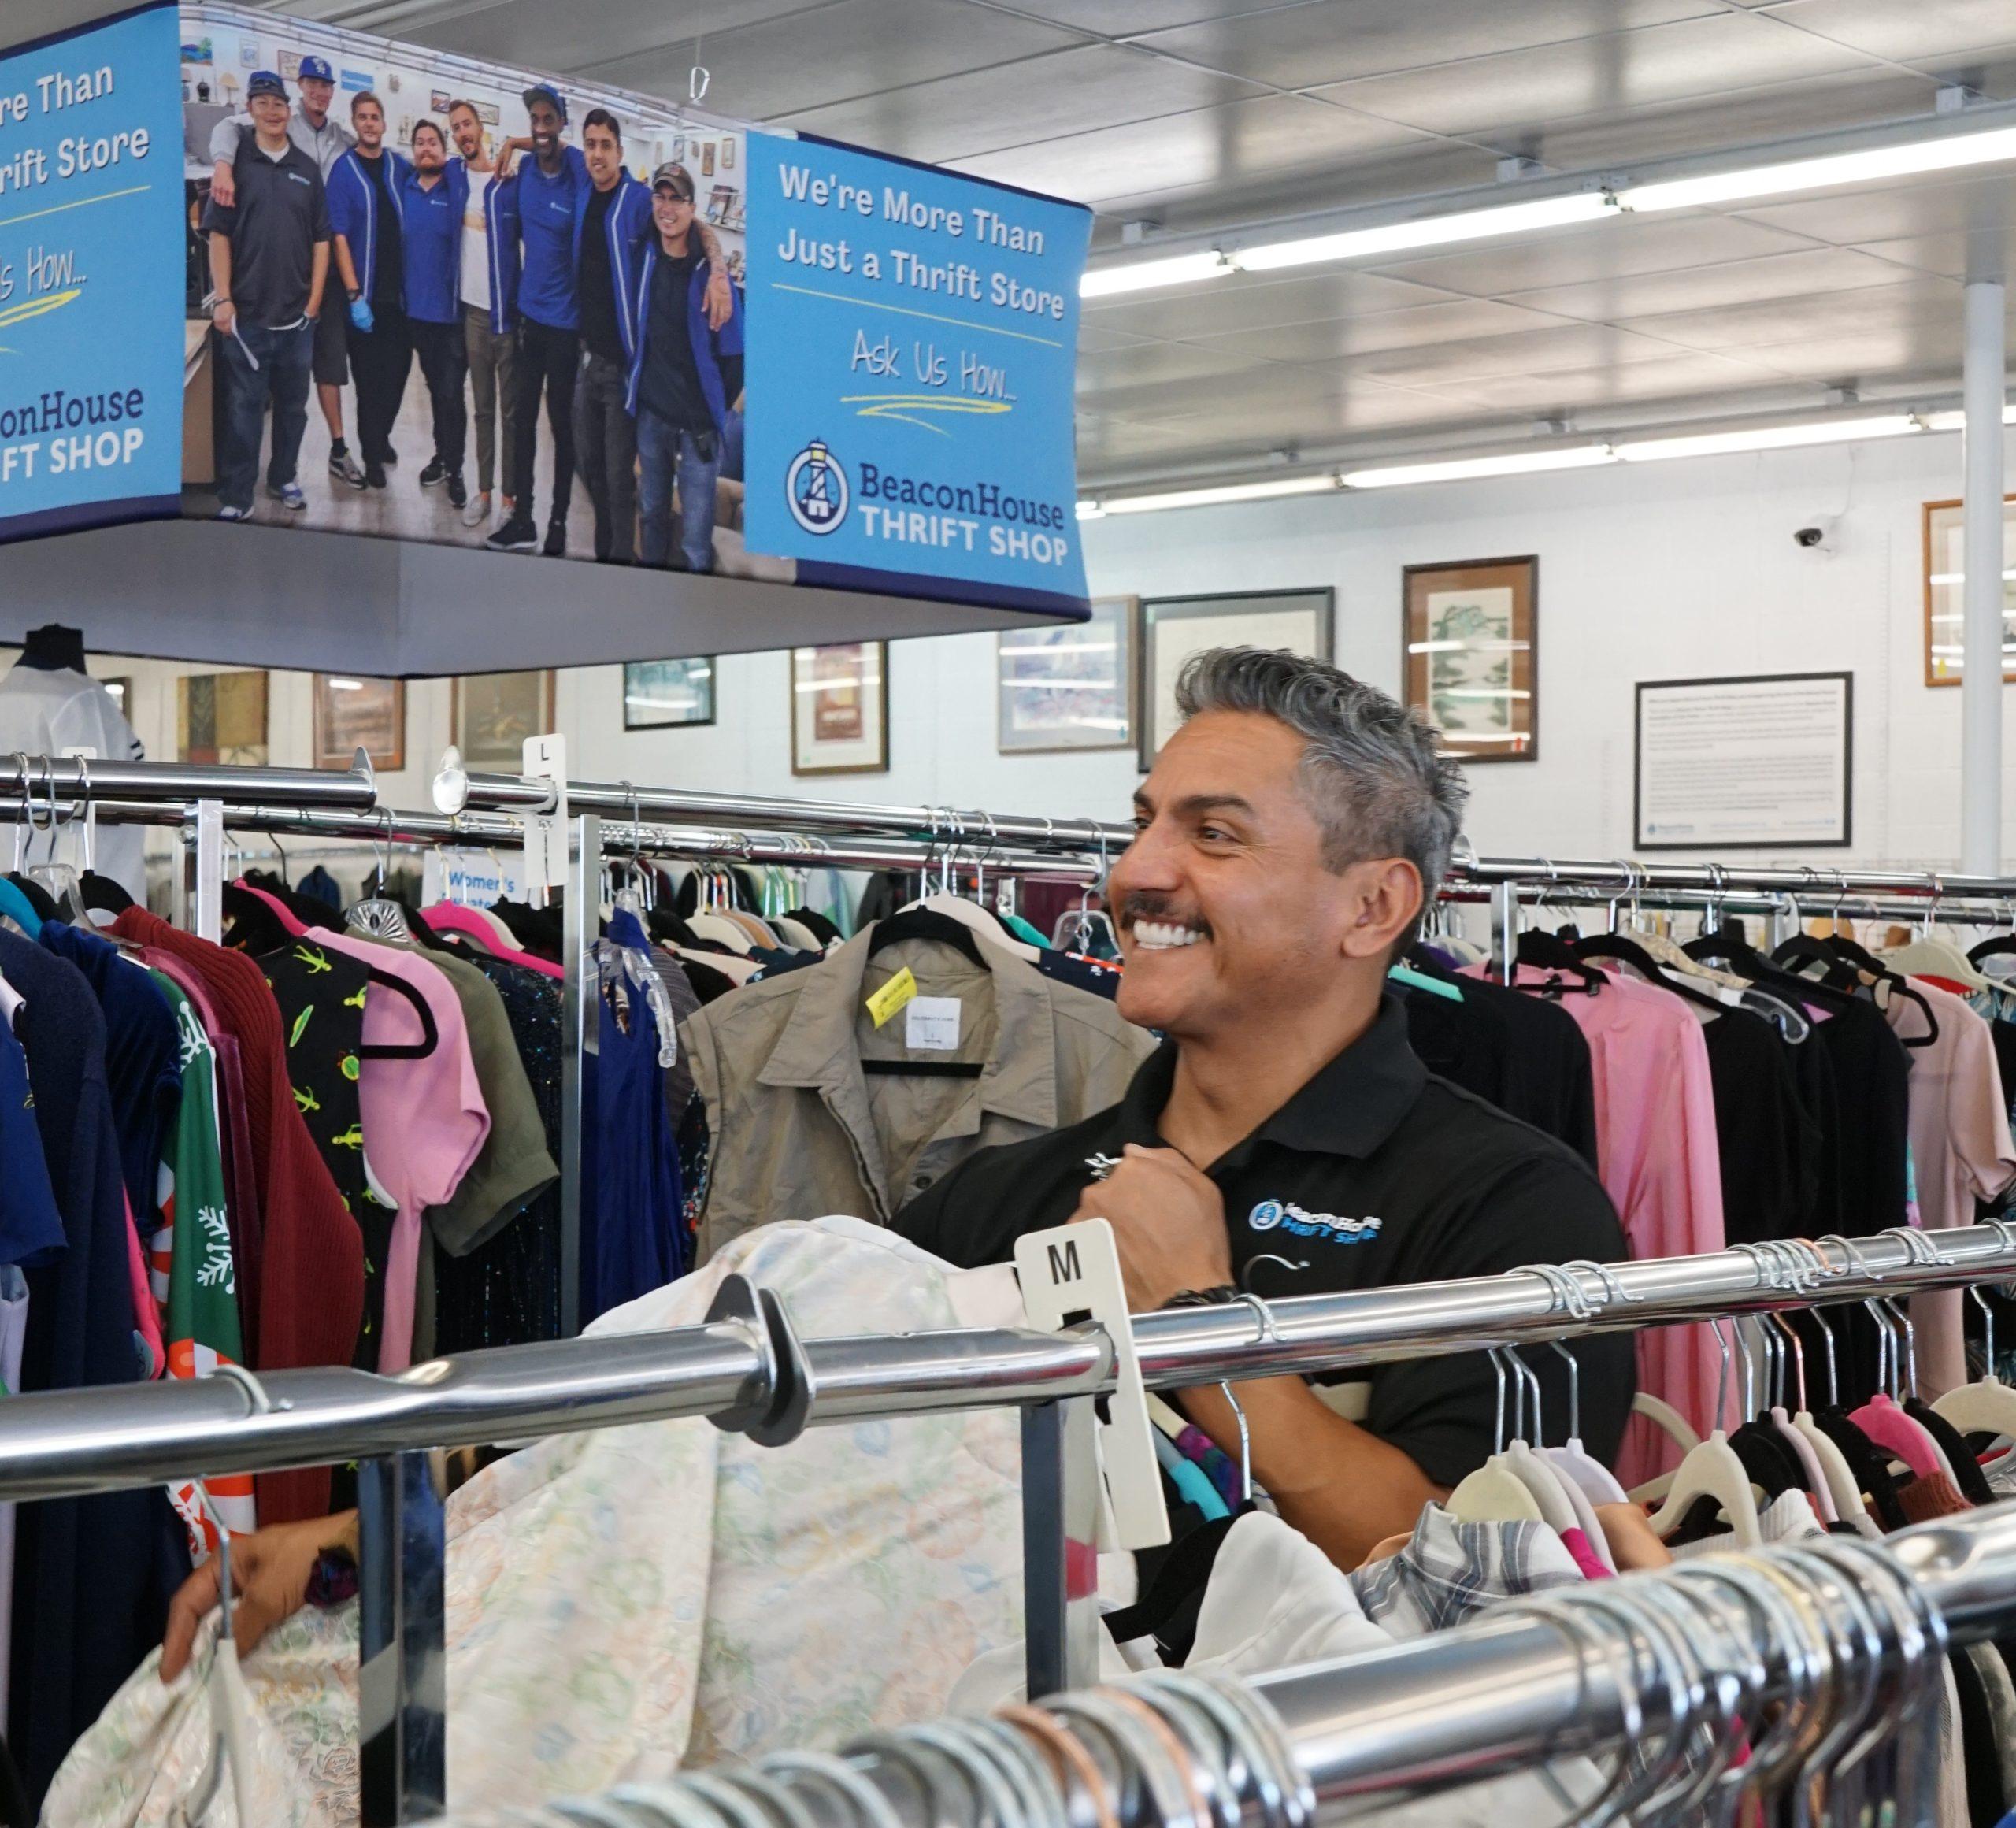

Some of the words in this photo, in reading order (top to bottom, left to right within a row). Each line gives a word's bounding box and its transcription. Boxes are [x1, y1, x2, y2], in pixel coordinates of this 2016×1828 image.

[36, 66, 113, 113] Than
[57, 128, 150, 178] Store
[779, 163, 874, 216] We're
[884, 187, 964, 236] More
[972, 208, 1044, 255] Than
[778, 228, 853, 274] Just
[862, 252, 881, 280] a
[890, 250, 982, 302] Thrift
[990, 272, 1065, 320] Store
[851, 328, 900, 378] Ask
[914, 341, 947, 386] Us
[50, 427, 145, 474] SHOP
[859, 462, 1065, 531] BeaconHouse
[858, 504, 979, 551] THRIFT
[989, 525, 1068, 566] SHOP
[540, 743, 550, 762] L
[1047, 1239, 1082, 1286] M
